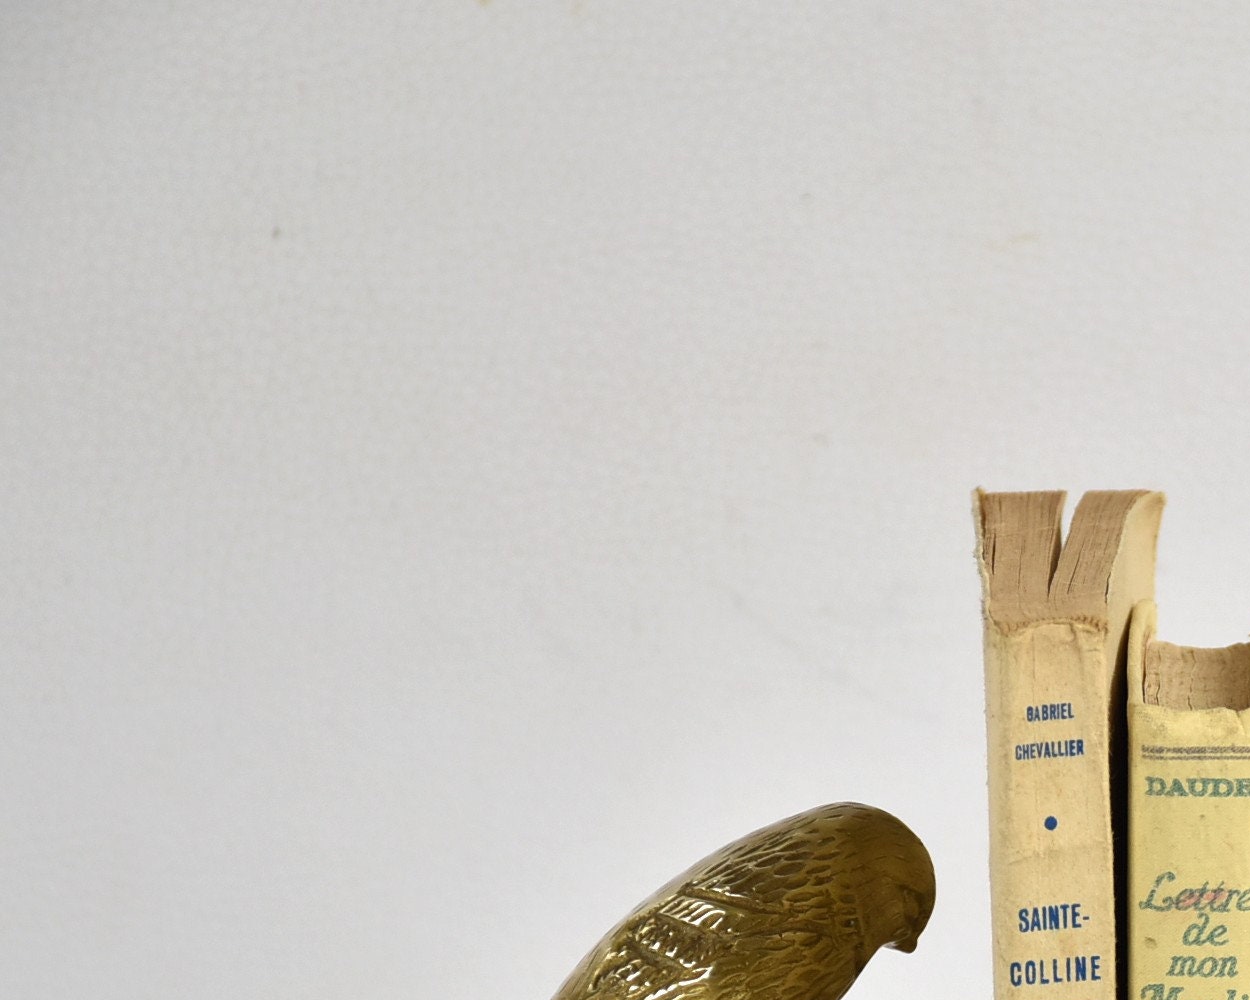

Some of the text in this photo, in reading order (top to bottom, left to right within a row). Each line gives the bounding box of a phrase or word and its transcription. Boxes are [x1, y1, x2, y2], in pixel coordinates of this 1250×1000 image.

[1015, 739, 1084, 761] CHEVALLIER
[1018, 903, 1090, 933] SAINTE-
[1182, 915, 1229, 947] de
[1009, 955, 1102, 986] COLLINE
[1166, 954, 1238, 978] mon
